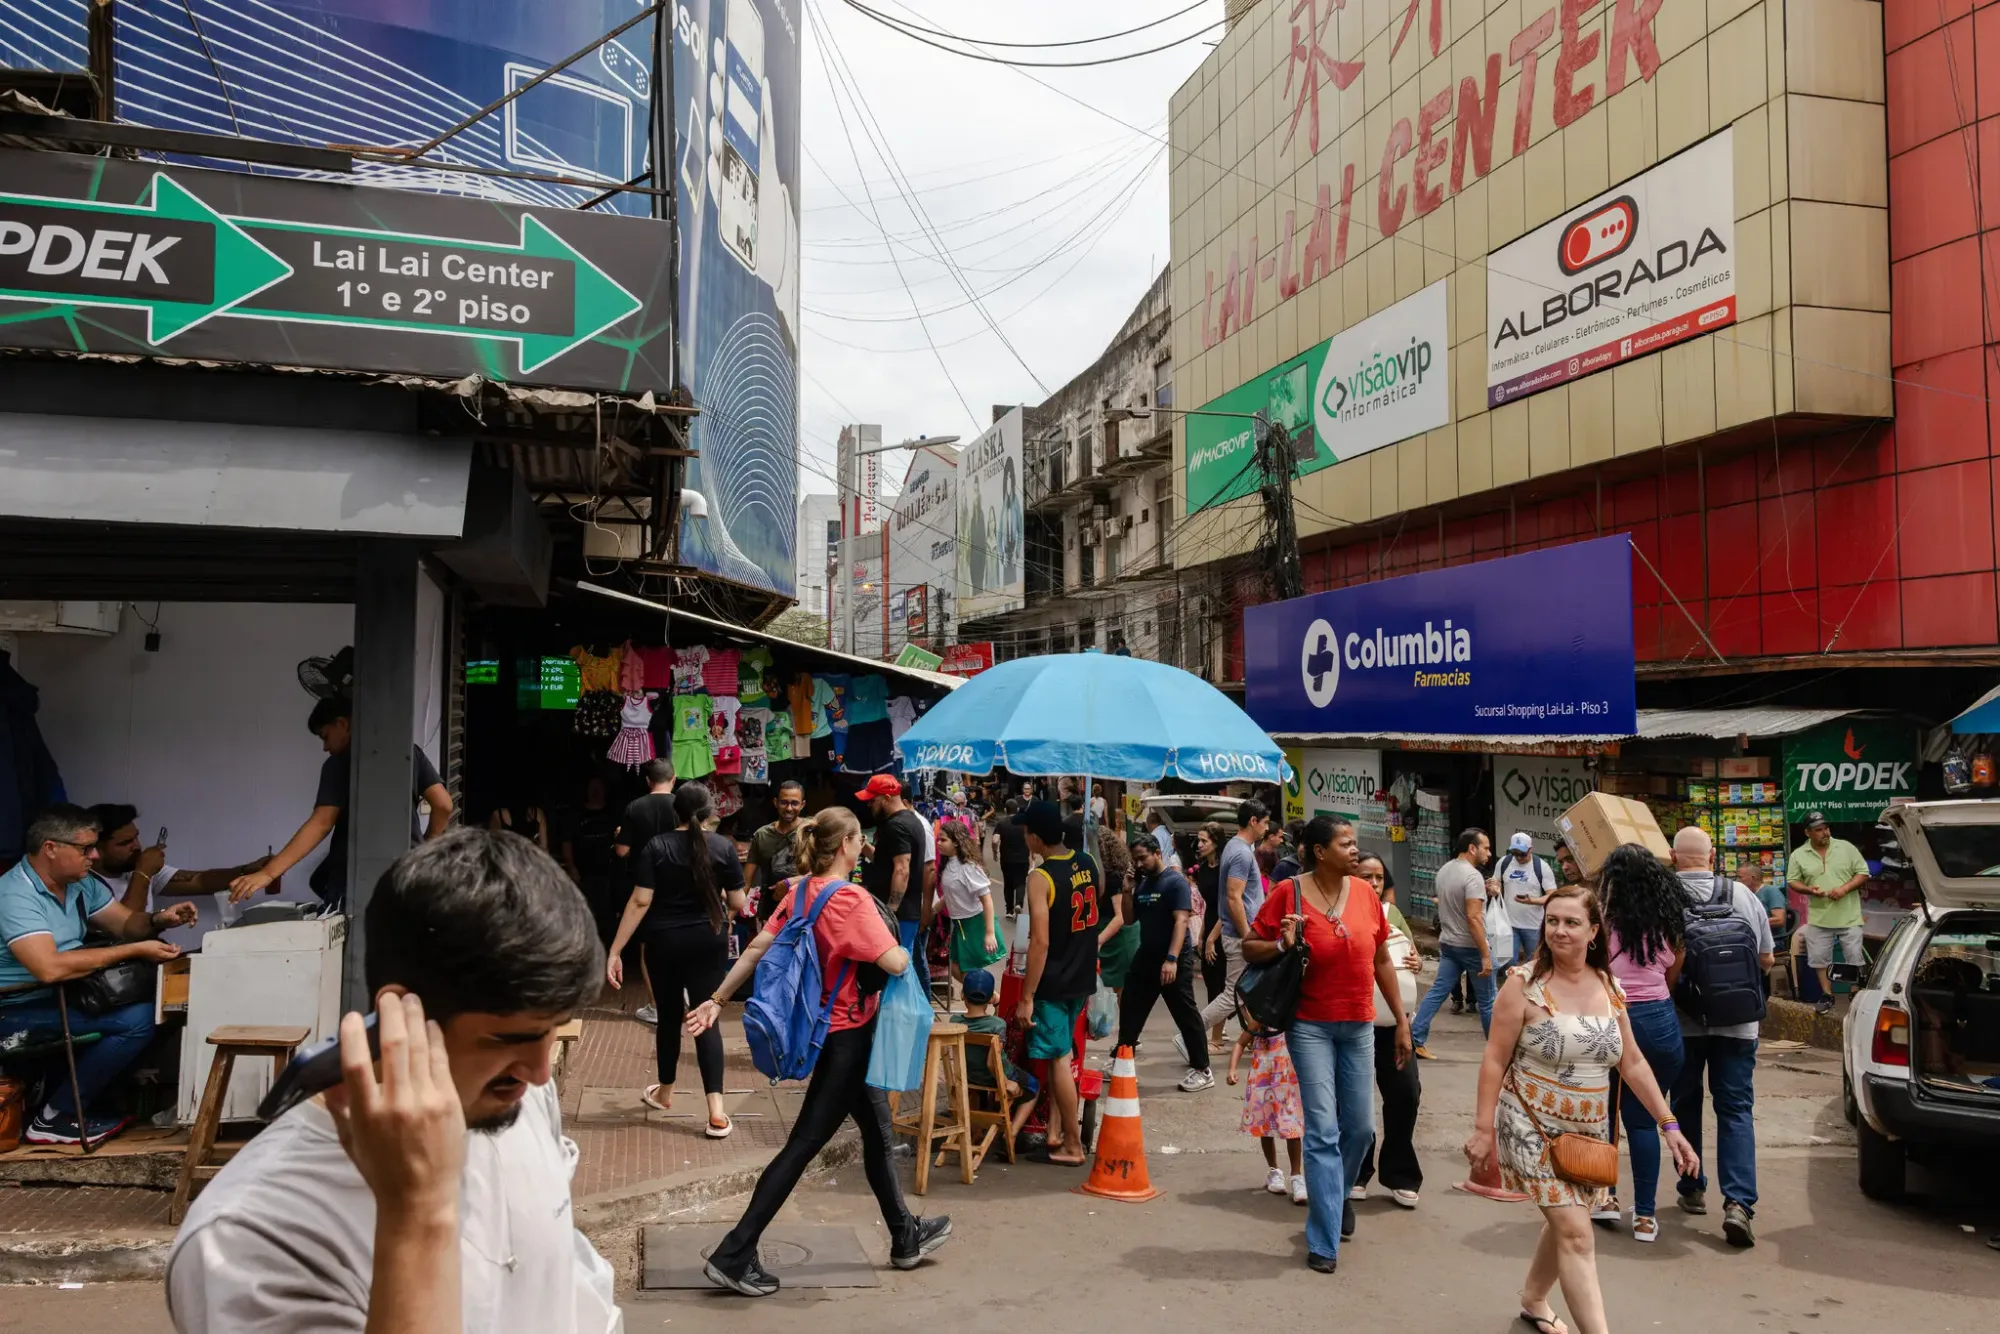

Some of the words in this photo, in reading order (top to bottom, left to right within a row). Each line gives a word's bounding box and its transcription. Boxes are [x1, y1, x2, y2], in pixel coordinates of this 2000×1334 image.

[1202, 163, 1355, 349] LAI-LAI
[1378, 0, 1663, 237] CENTER
[313, 241, 365, 271] Lai
[379, 247, 429, 277] Lai
[441, 254, 554, 289] Center
[1493, 227, 1727, 349] ALBORADA
[382, 291, 401, 312] e
[459, 294, 531, 324] piso
[1491, 351, 1530, 372] Informática
[1535, 334, 1570, 356] Celulares
[1575, 313, 1621, 340] Eletrônicos
[1627, 295, 1668, 319] Perfumes
[1675, 270, 1731, 300] Cosméticos
[1348, 336, 1431, 401] visãovip
[1341, 382, 1417, 424] Informática
[965, 427, 1005, 479] ALASKA
[1203, 431, 1250, 464] MACROVIP
[1345, 619, 1471, 670] Columbia
[1413, 668, 1471, 688] Farmacias
[1474, 703, 1506, 717] Sucursal
[1507, 703, 1545, 719] Shopping
[1546, 702, 1574, 716] Lai-Lai
[1581, 701, 1600, 715] Piso
[1602, 701, 1609, 714] 3
[916, 745, 974, 765] HONOR
[1200, 752, 1269, 774] HONOR
[1324, 768, 1375, 801] visãovip
[1796, 761, 1912, 792] TOPDEK
[1793, 801, 1805, 810] LAI
[1806, 801, 1818, 810] LAI
[1828, 800, 1843, 810] Piso
[1847, 799, 1890, 808] www.topdek
[1071, 885, 1099, 933] 23
